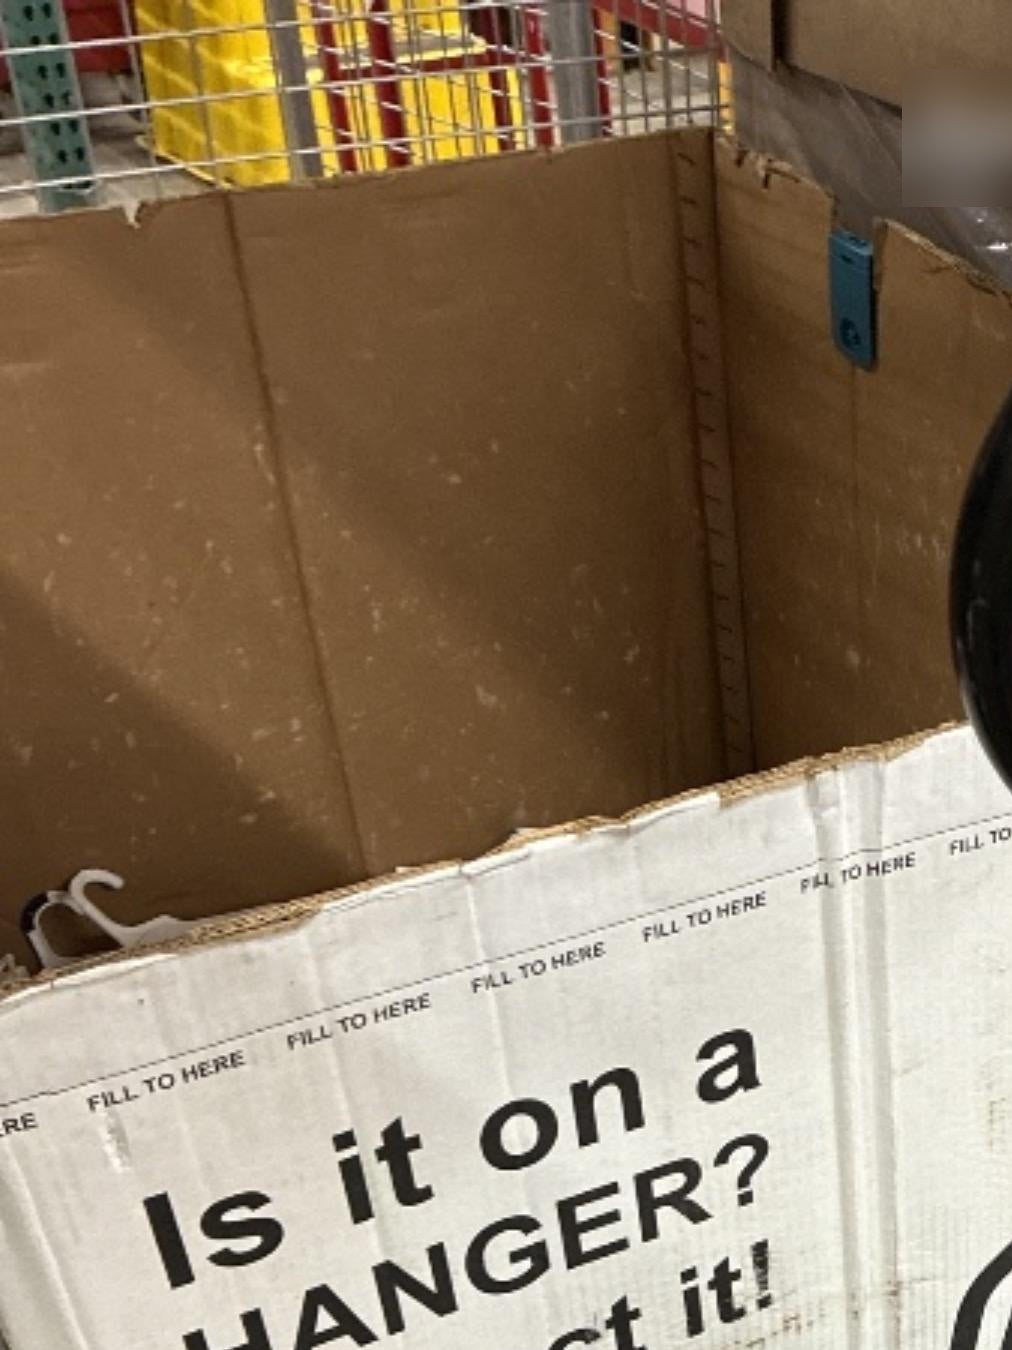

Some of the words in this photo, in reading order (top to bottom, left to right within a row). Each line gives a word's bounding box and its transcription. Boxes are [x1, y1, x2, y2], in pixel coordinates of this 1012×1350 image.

[950, 834, 984, 855] FILL
[989, 827, 1012, 844] TO
[800, 872, 834, 893] FILL
[841, 864, 862, 883] TO
[866, 852, 916, 877] HERE
[642, 920, 680, 943] FILL
[687, 909, 712, 927] TO
[716, 890, 767, 918] HERE
[470, 971, 513, 993] FILL
[519, 959, 546, 980] TO
[551, 941, 606, 970] HERE
[286, 1026, 332, 1050] FILL
[337, 1013, 367, 1033] TO
[373, 992, 432, 1023] HERE
[86, 1085, 139, 1112] FILL
[143, 1073, 175, 1093] TO
[181, 1050, 246, 1083] HERE
[0, 1113, 38, 1137] RE
[143, 1191, 284, 1291] Is
[332, 1114, 435, 1225] it
[480, 1061, 646, 1171] on
[696, 1027, 764, 1103] a
[680, 1239, 776, 1339] it!
